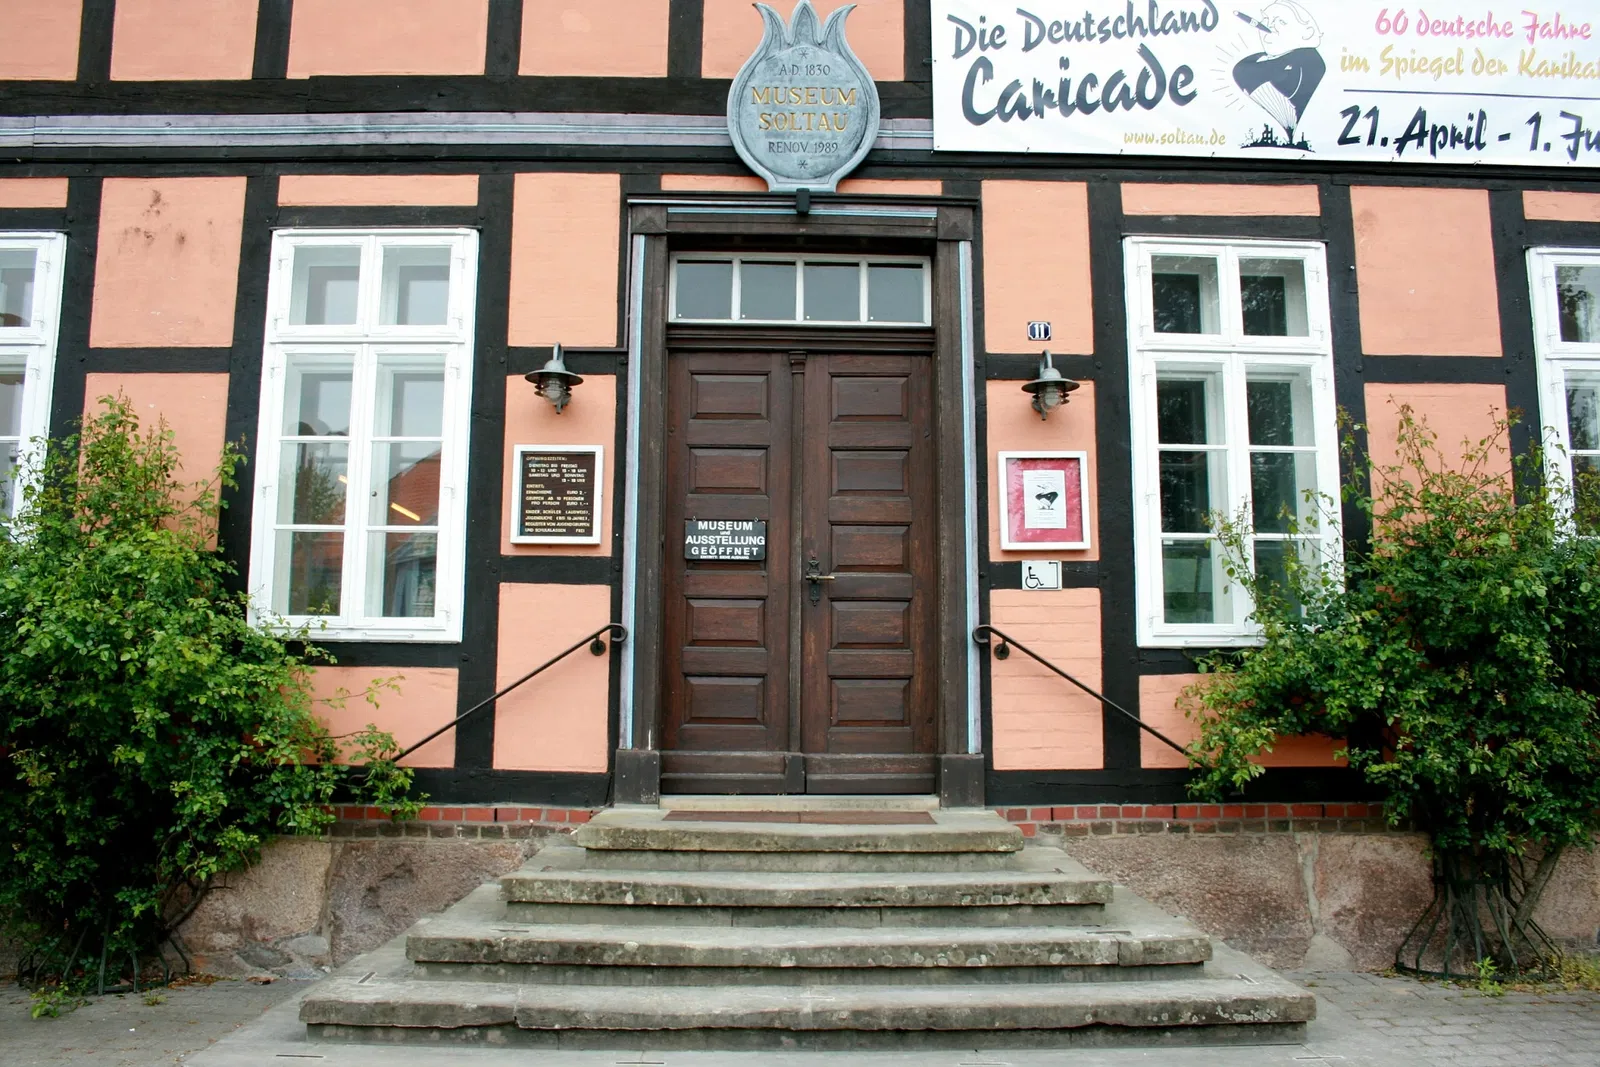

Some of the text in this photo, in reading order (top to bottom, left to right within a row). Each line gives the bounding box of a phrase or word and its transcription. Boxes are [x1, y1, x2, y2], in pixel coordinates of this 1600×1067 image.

[947, 0, 1219, 59] Die Deutschland
[1375, 8, 1593, 45] 60 deutsche Jahre
[805, 64, 831, 76] 1830
[1340, 44, 1600, 81] im Spiegel der Karika
[962, 43, 1198, 126] Caricade
[751, 86, 856, 105] MUSEUM
[759, 112, 848, 132] SOLTAU
[1338, 105, 1388, 147] 21.
[1394, 106, 1487, 158] April
[1525, 110, 1551, 152] 1.
[1124, 127, 1226, 146] www.soltau.de
[814, 141, 838, 153] 1989
[1033, 323, 1045, 339] 11
[698, 521, 753, 531] MUSEUM
[685, 535, 765, 545] AUSSTELLUNG
[691, 545, 759, 556] GEÖFFNET
